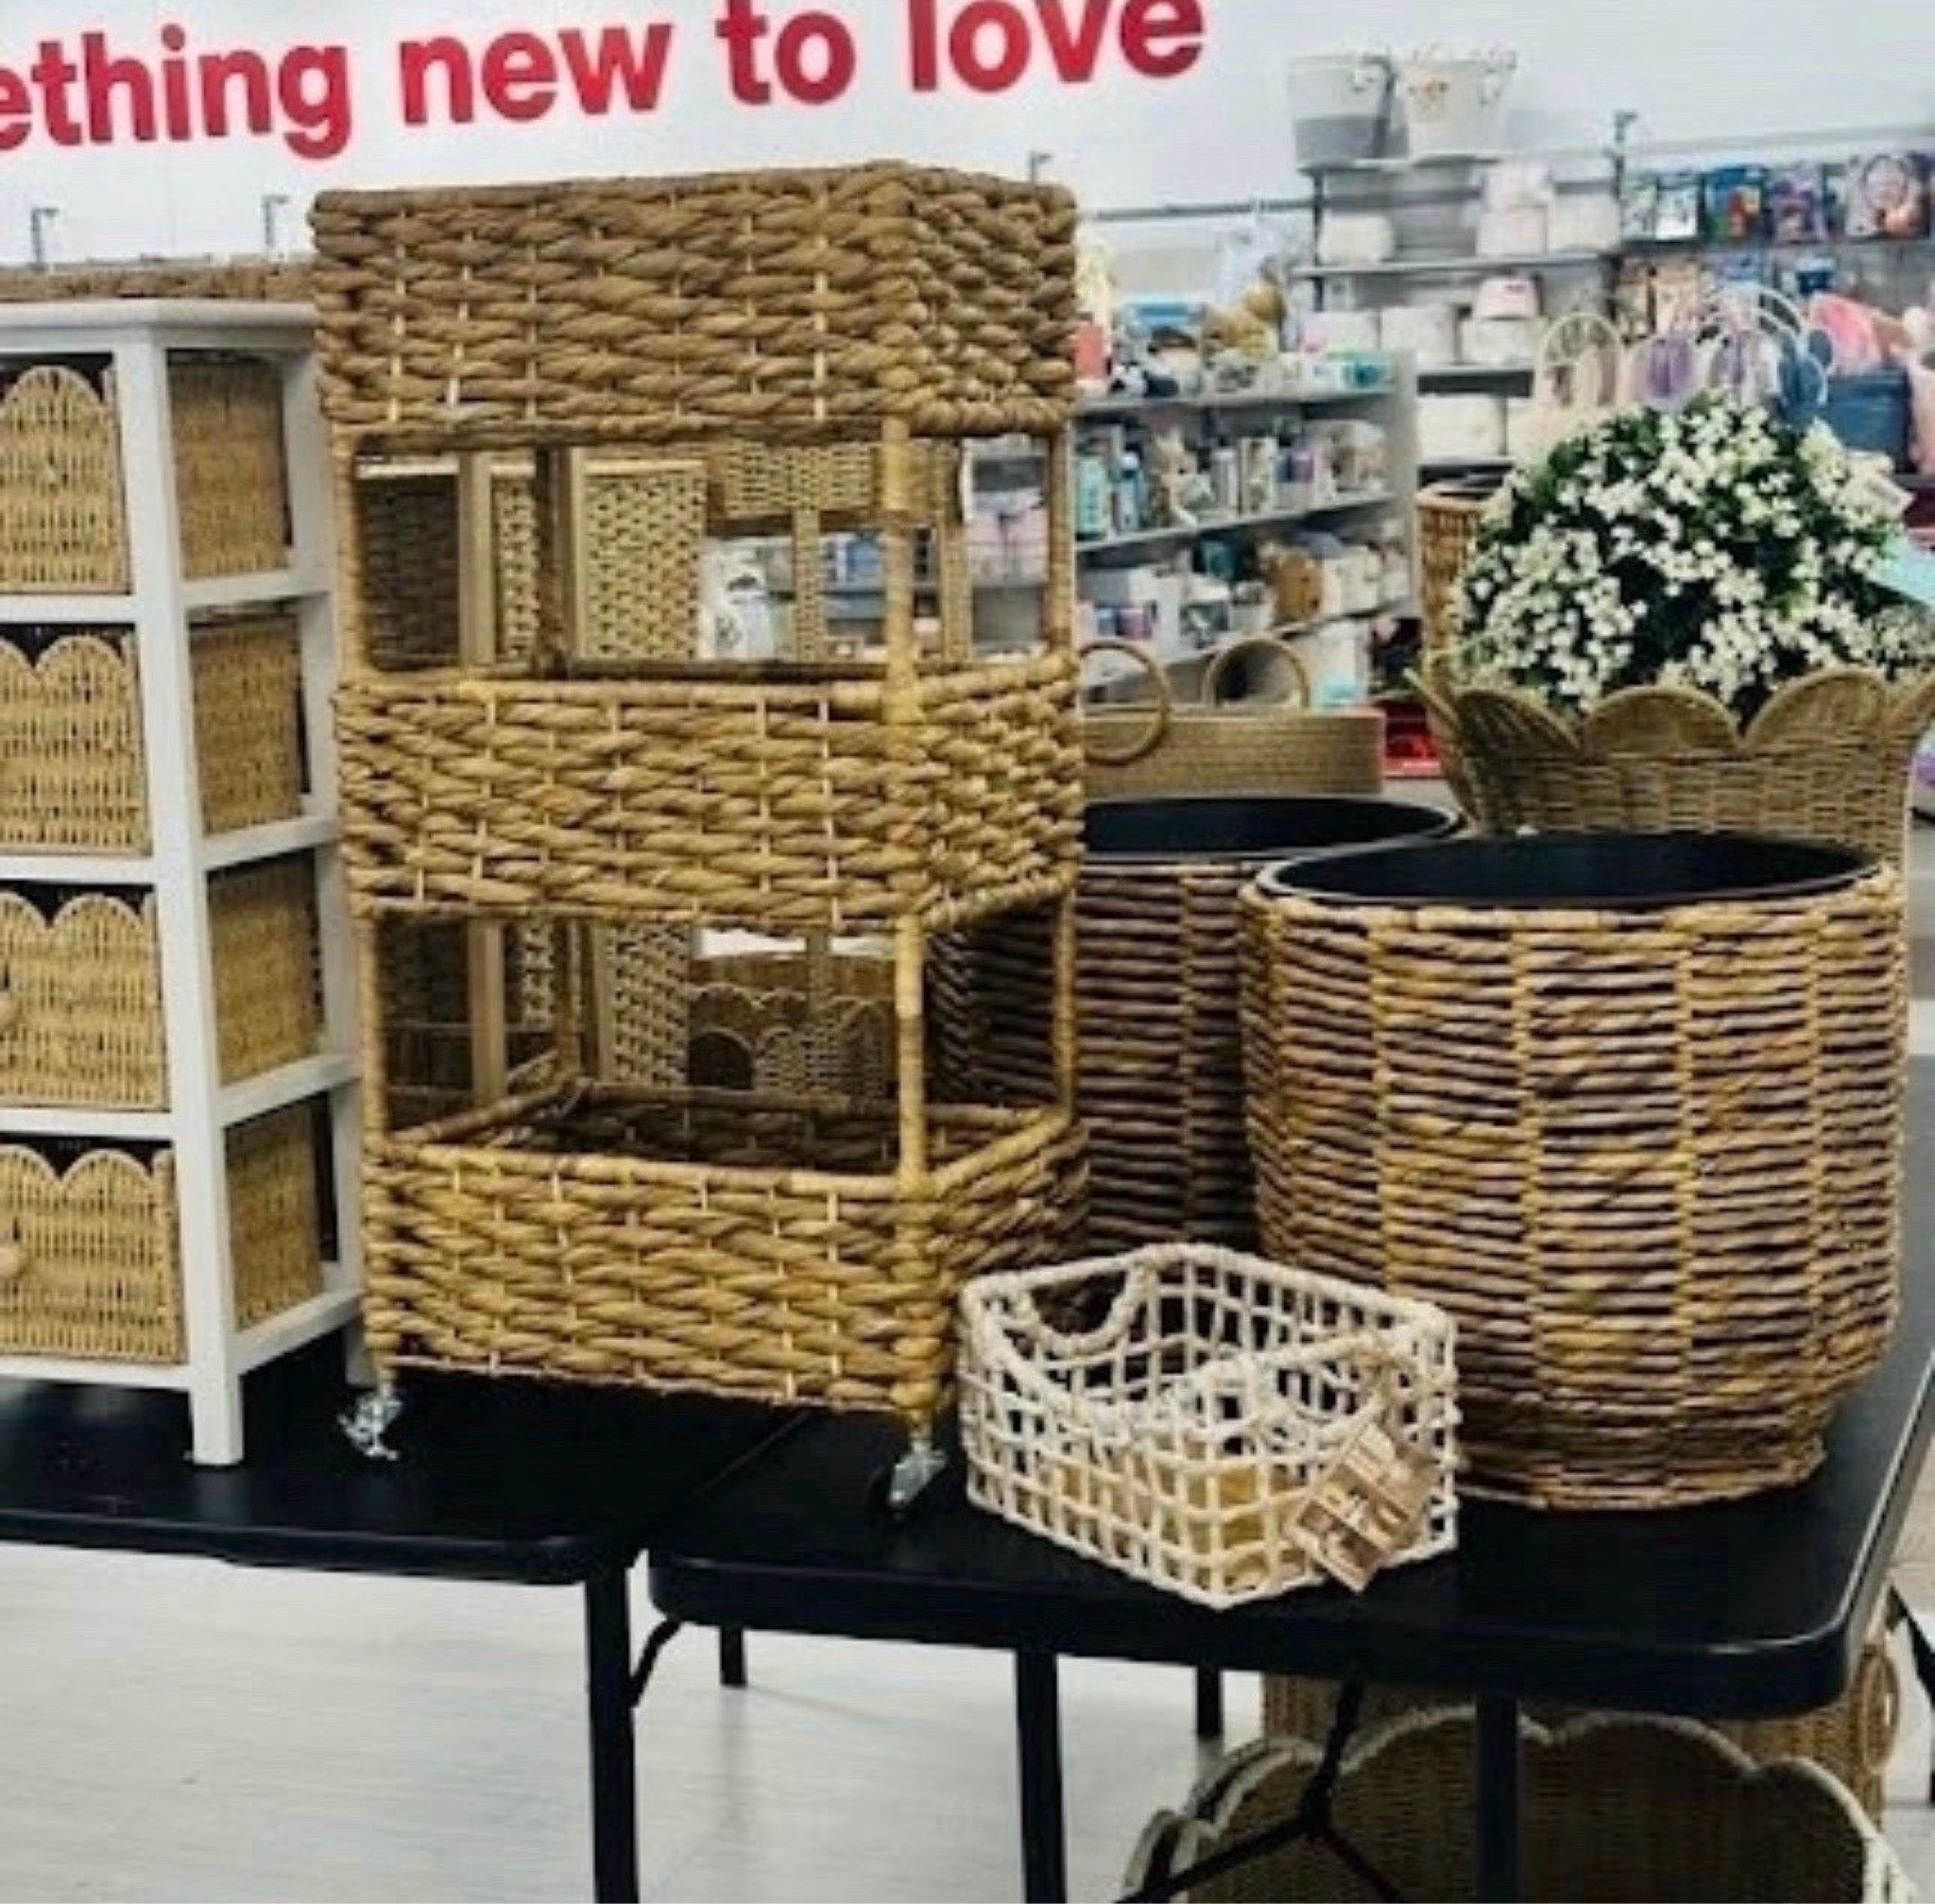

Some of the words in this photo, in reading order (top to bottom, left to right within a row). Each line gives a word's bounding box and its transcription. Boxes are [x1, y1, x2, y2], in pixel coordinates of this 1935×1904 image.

[397, 25, 674, 127] new
[716, 0, 857, 105] to
[905, 0, 1206, 94] love
